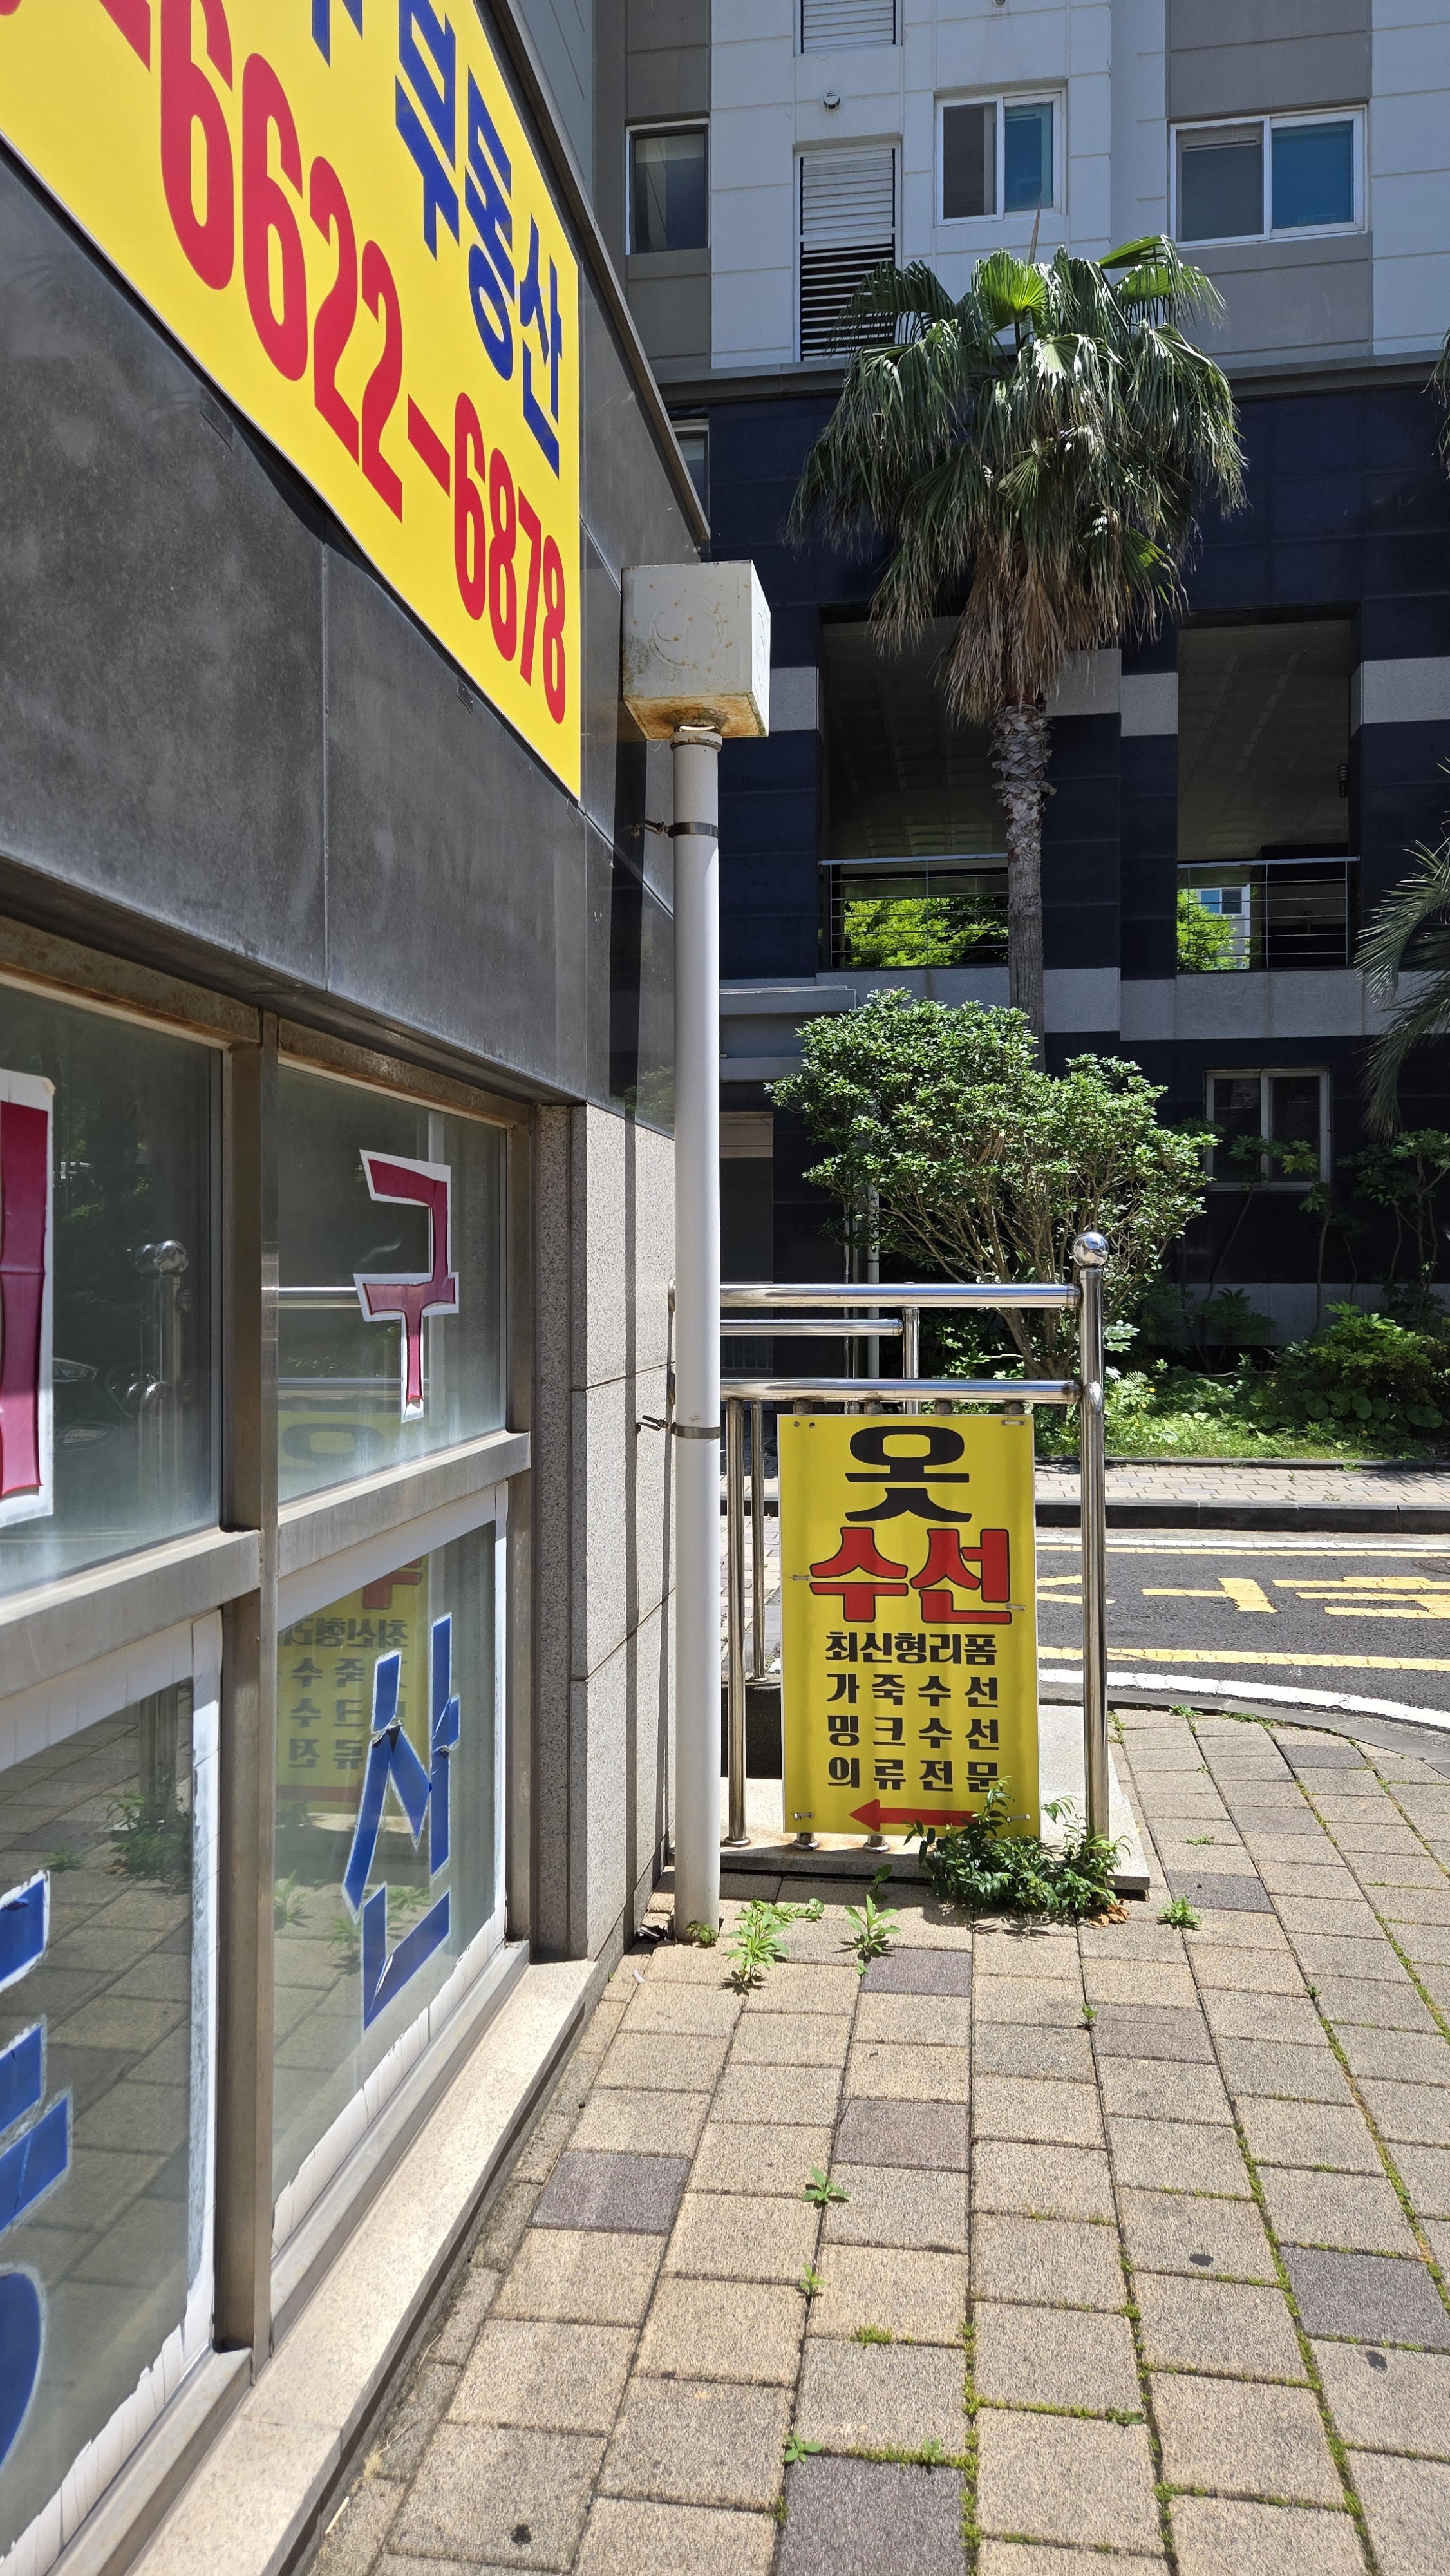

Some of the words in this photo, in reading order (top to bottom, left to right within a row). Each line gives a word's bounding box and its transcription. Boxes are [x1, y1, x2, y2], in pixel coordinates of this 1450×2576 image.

[395, 0, 562, 479] 부동산
[845, 1425, 972, 1522] 옷
[809, 1527, 1012, 1624] 수선
[825, 1631, 997, 1665] 최신형리폼
